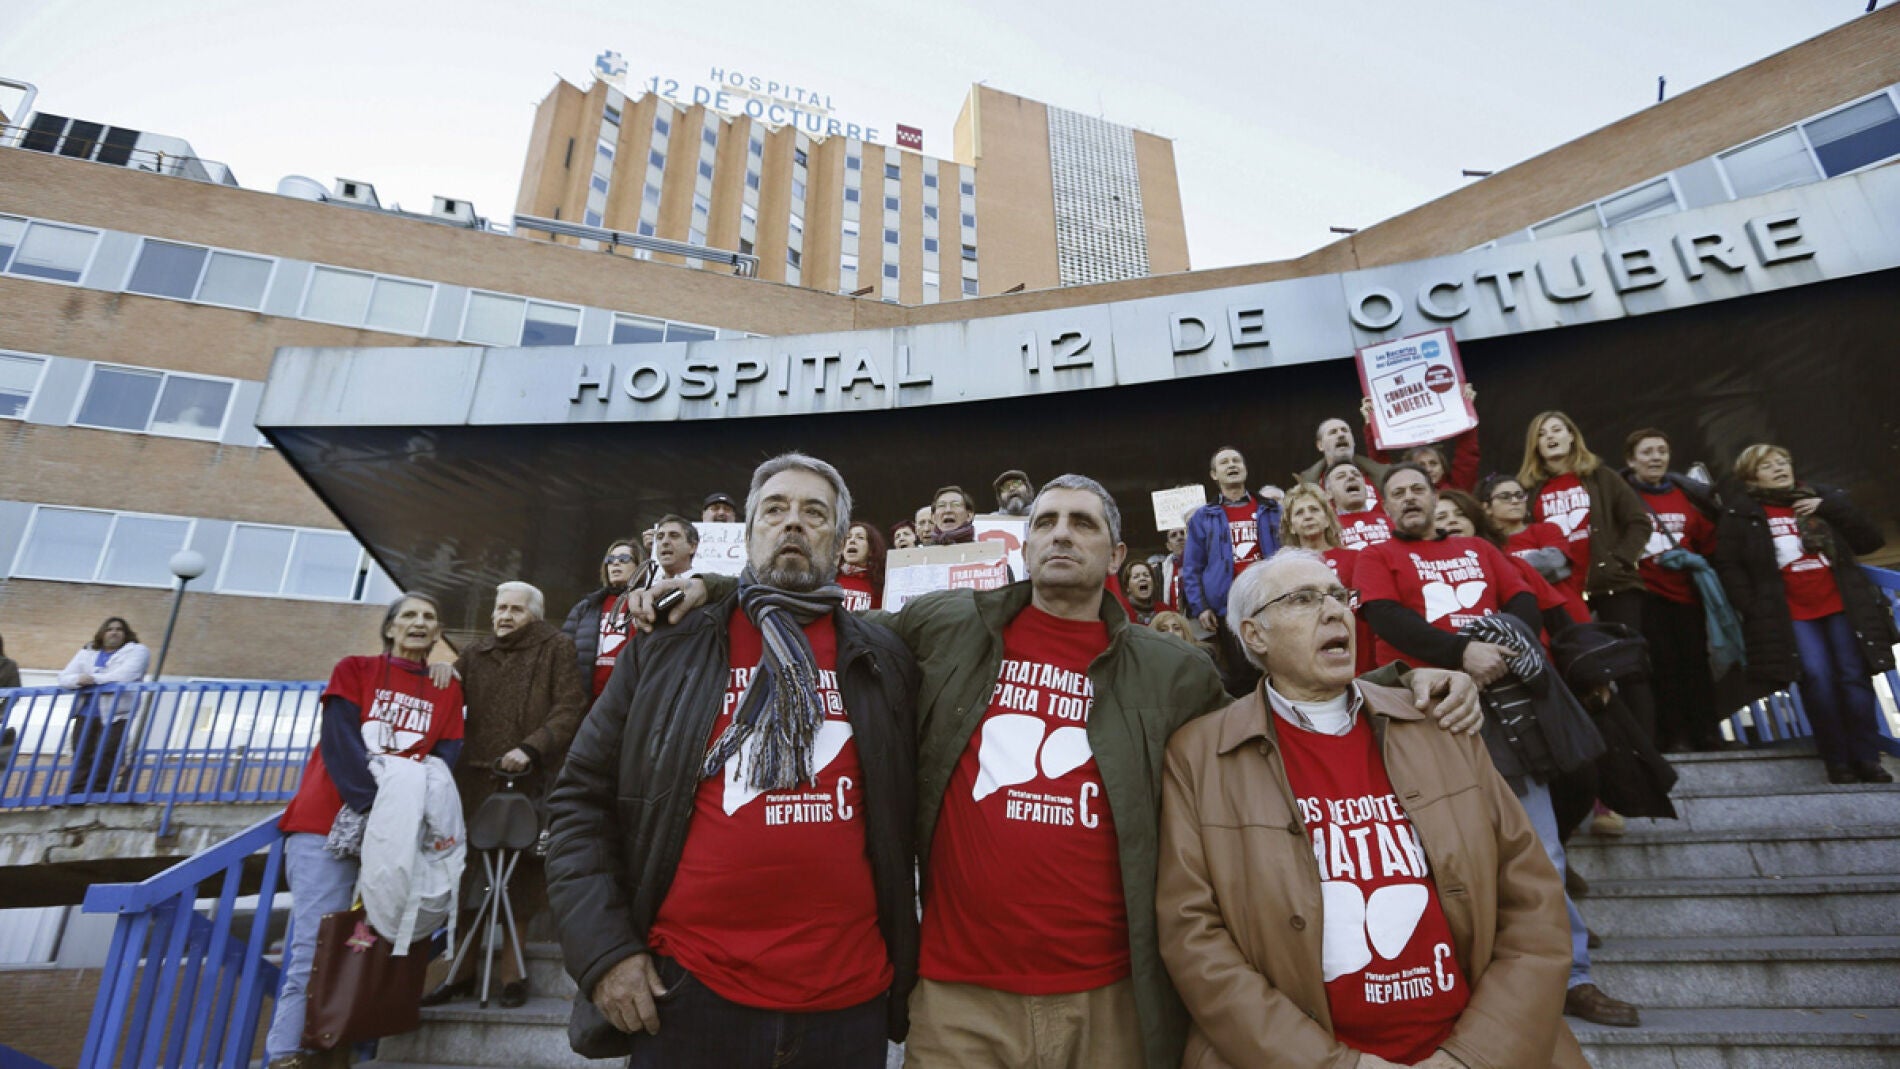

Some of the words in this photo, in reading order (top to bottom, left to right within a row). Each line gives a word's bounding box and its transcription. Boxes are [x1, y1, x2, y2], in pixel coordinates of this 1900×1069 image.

[650, 76, 680, 99] 12
[693, 86, 730, 111] DE
[746, 102, 880, 142] OCTUBRE
[711, 67, 836, 111] HOSPITAL
[570, 345, 933, 403] HOSPITAL
[1020, 326, 1094, 375] 12
[1170, 307, 1271, 356] DE
[1348, 208, 1817, 332] OCTUBRE
[1392, 392, 1434, 416] MUERTE
[989, 684, 1039, 712] PARA
[766, 803, 833, 826] HEPATITIS
[837, 776, 853, 821] C
[1006, 800, 1075, 827] HEPATITIS
[1080, 781, 1099, 829] C
[1364, 977, 1433, 1005] HEPATITIS
[1433, 943, 1455, 992] C
